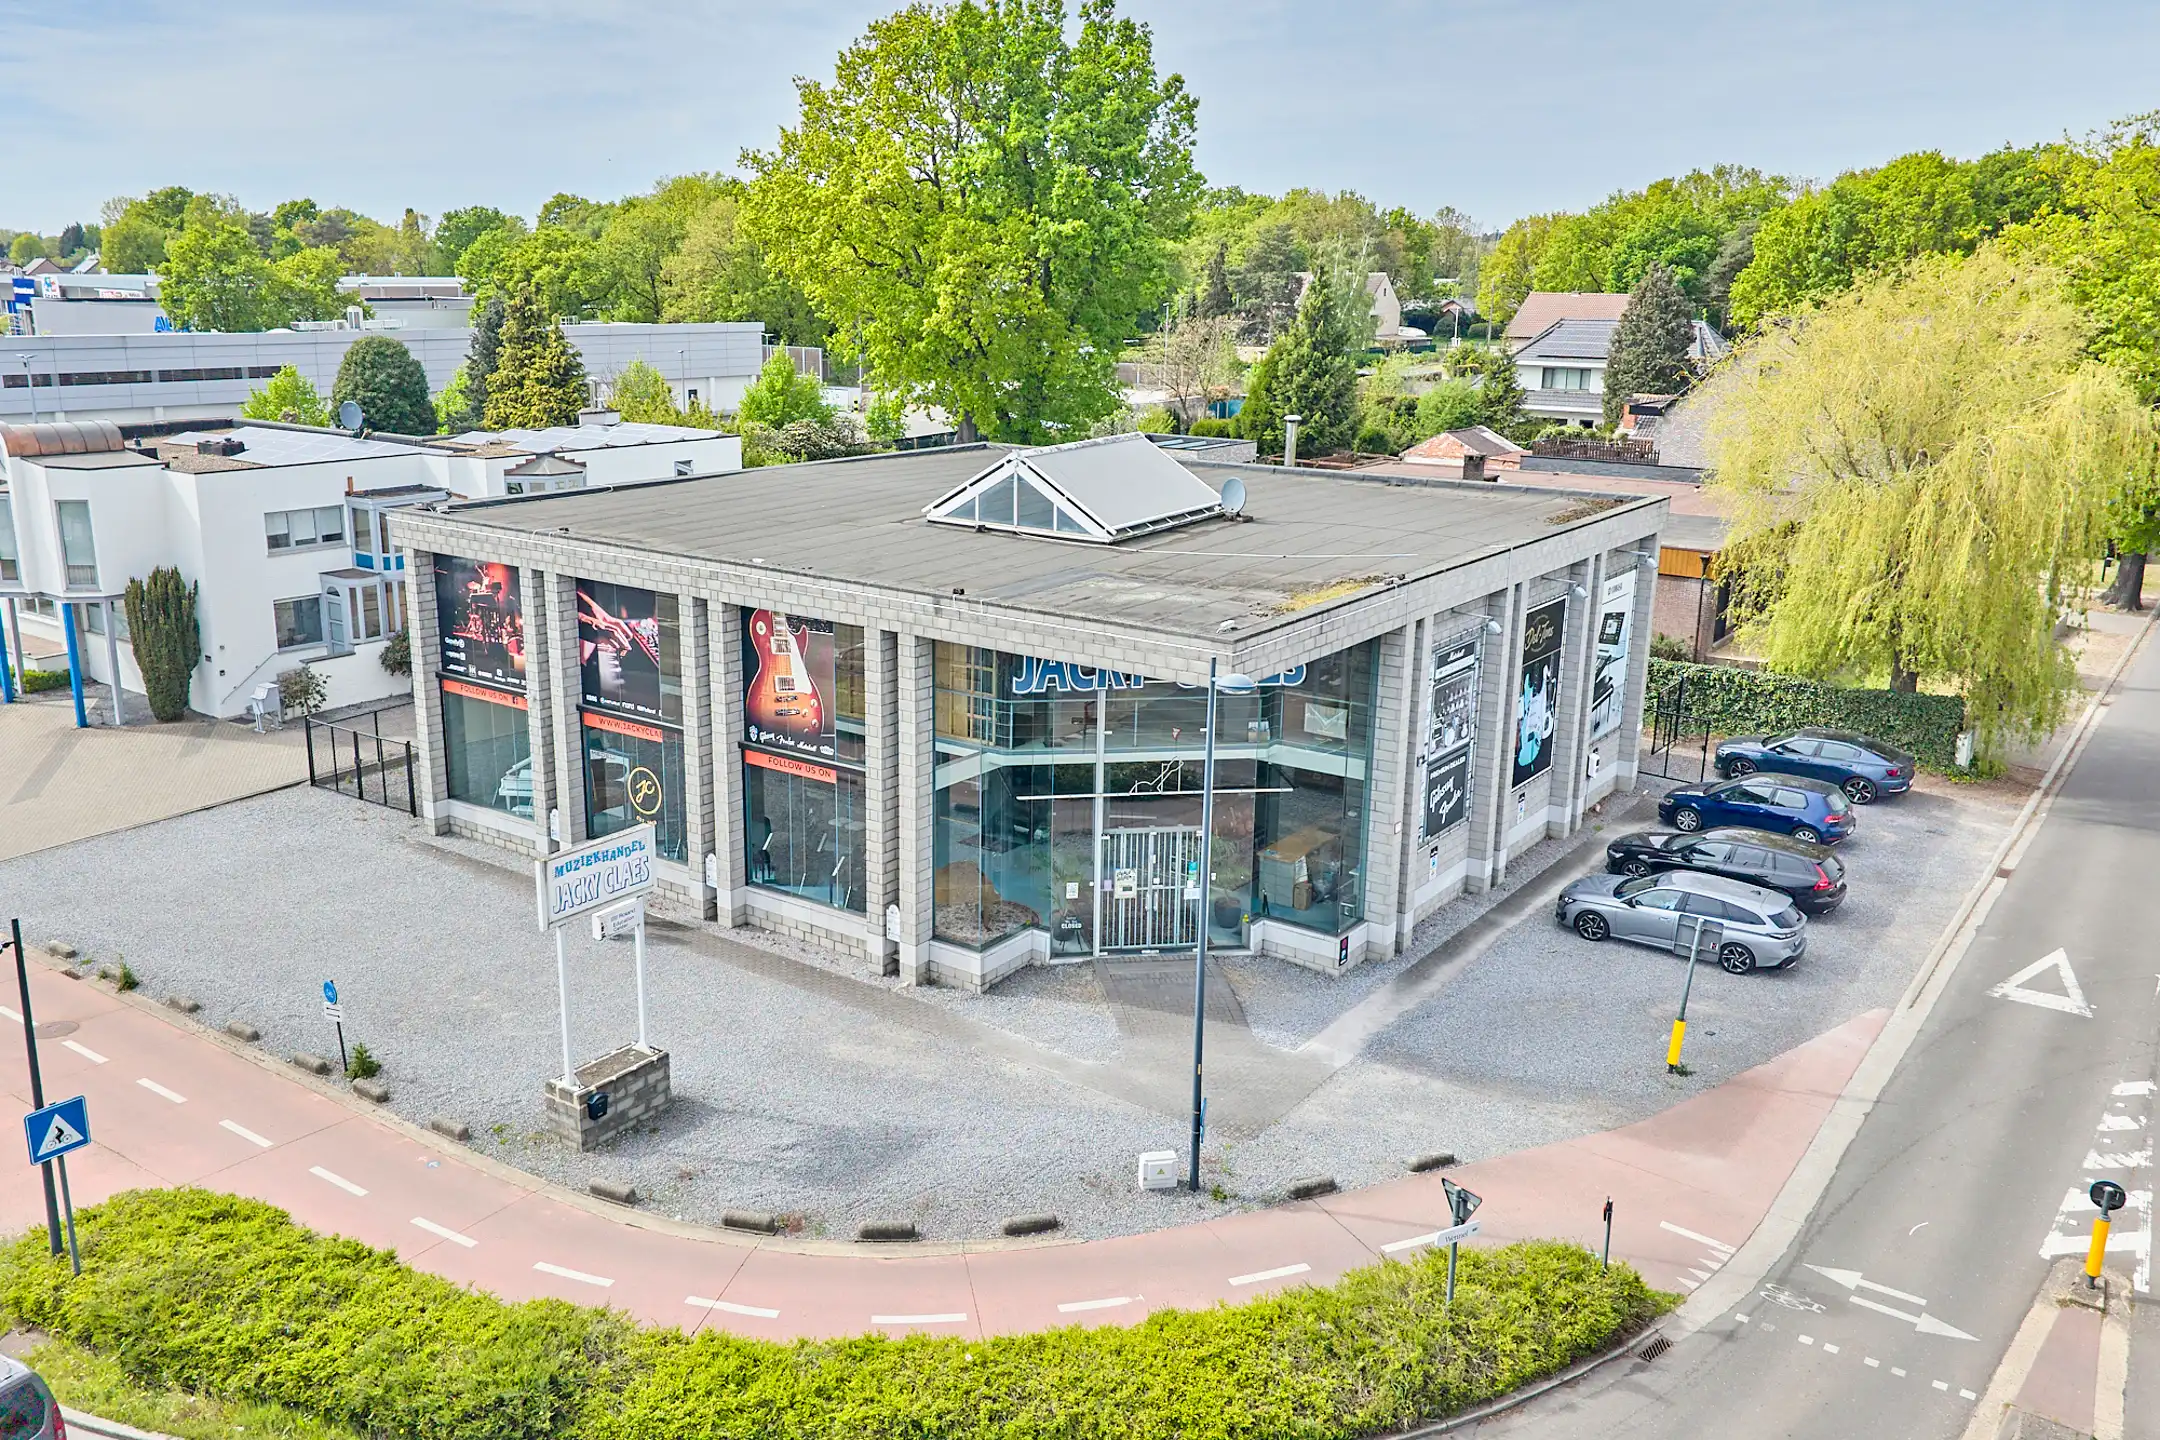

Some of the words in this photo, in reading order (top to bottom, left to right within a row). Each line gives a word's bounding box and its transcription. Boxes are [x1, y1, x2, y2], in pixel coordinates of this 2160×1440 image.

[460, 684, 487, 696] FOLLOW
[489, 690, 497, 698] US
[499, 693, 509, 701] ON
[768, 756, 802, 771] FOLLOW
[805, 765, 816, 774] US
[818, 769, 831, 778] ON
[554, 839, 646, 878] MUZIEKHANDEL
[553, 871, 601, 915] JACKY
[603, 855, 650, 895] CLAES
